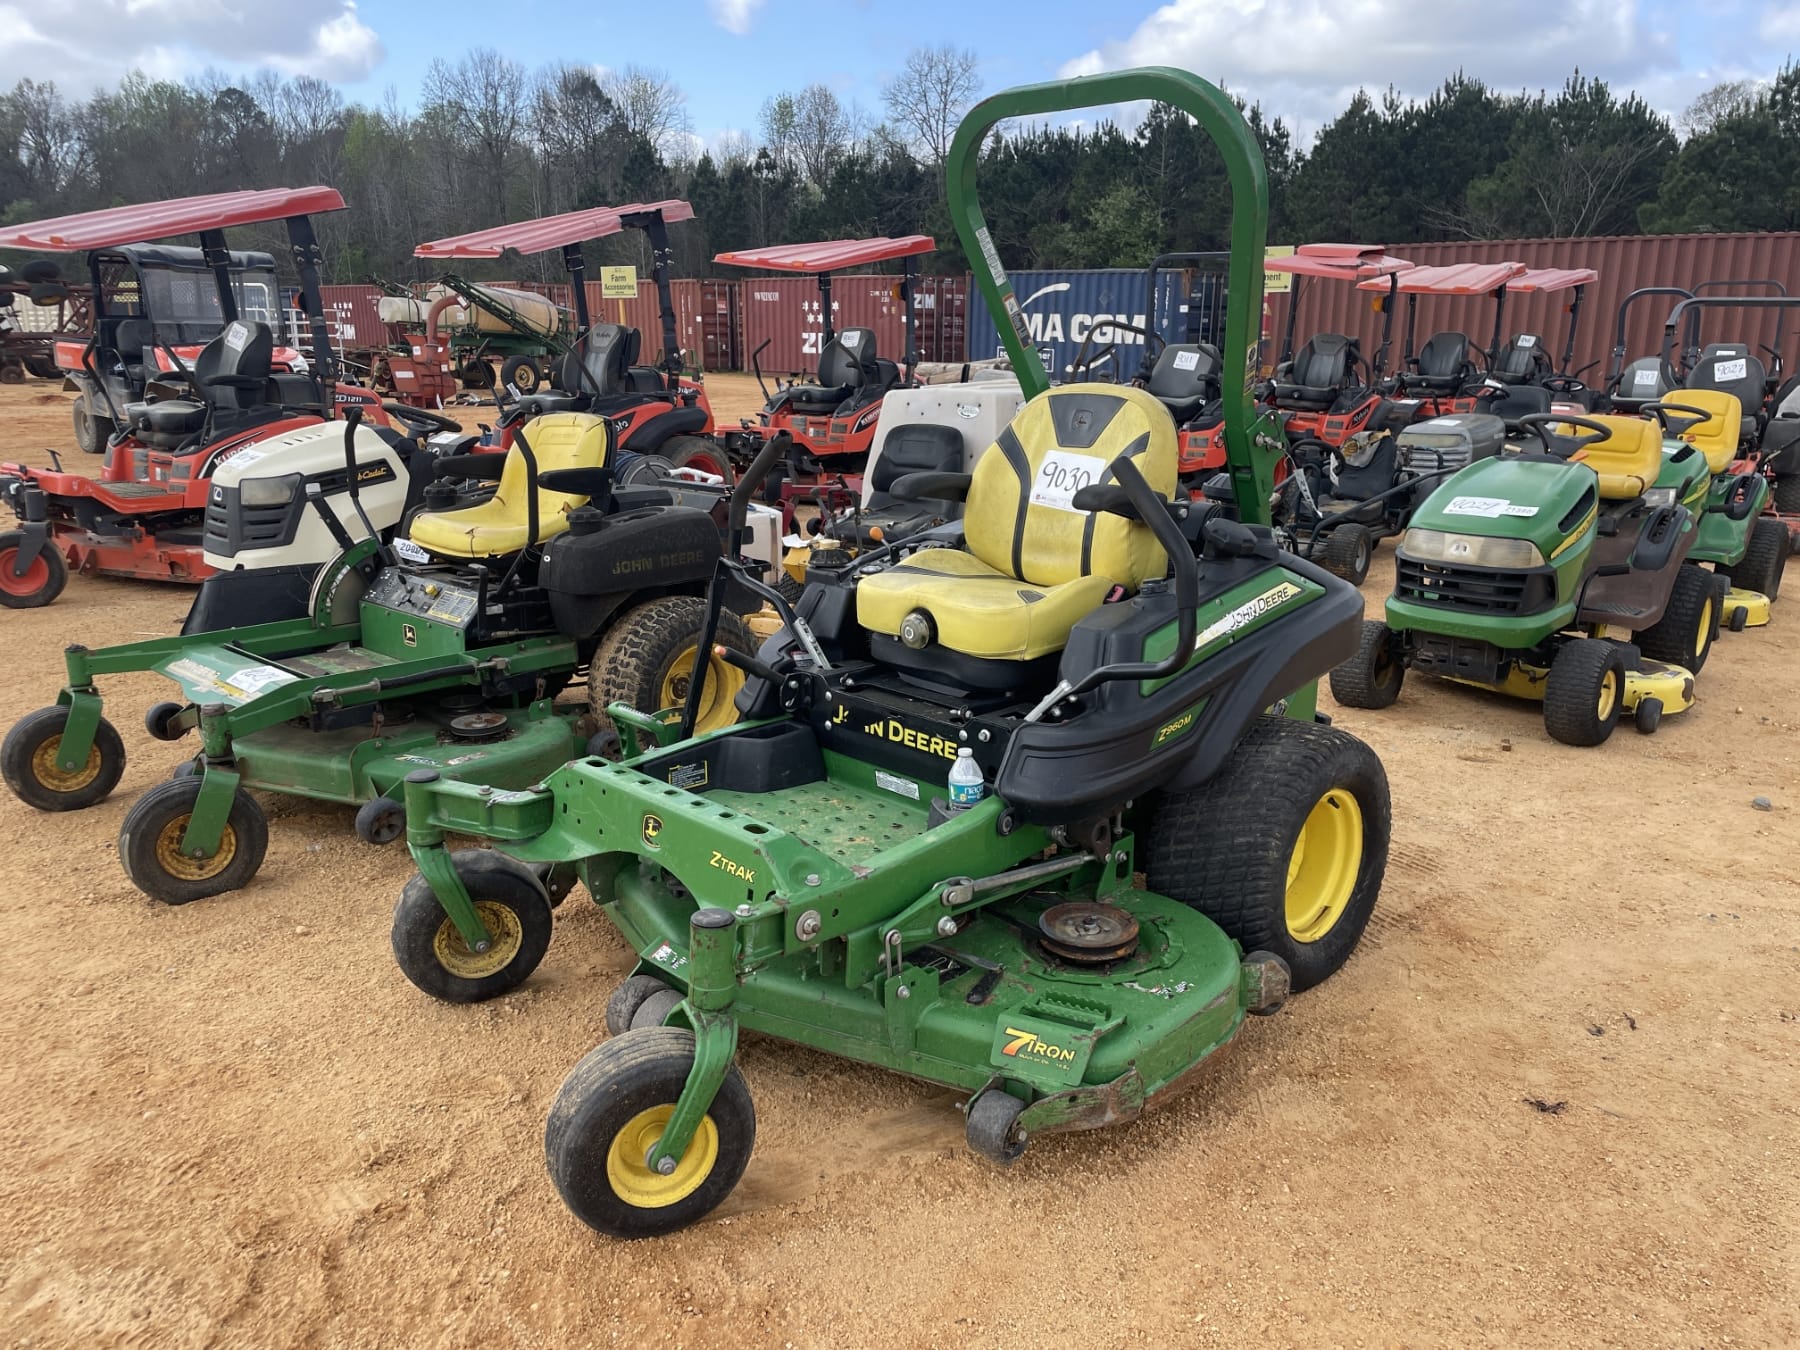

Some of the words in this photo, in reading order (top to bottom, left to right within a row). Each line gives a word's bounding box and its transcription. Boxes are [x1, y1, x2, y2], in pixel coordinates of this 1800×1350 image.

[610, 274, 627, 282] Farm
[913, 293, 935, 309] ZIM
[1018, 313, 1065, 342] MA
[1070, 313, 1146, 345] CGM
[1042, 461, 1091, 492] 9030
[612, 557, 653, 575] JOHN
[660, 550, 704, 568] DEERE
[1230, 605, 1257, 629] JOHN
[1258, 586, 1290, 613] DEERE
[888, 719, 958, 761] DEERE
[1157, 714, 1192, 742] Z960M
[710, 850, 755, 883] ZTRAK
